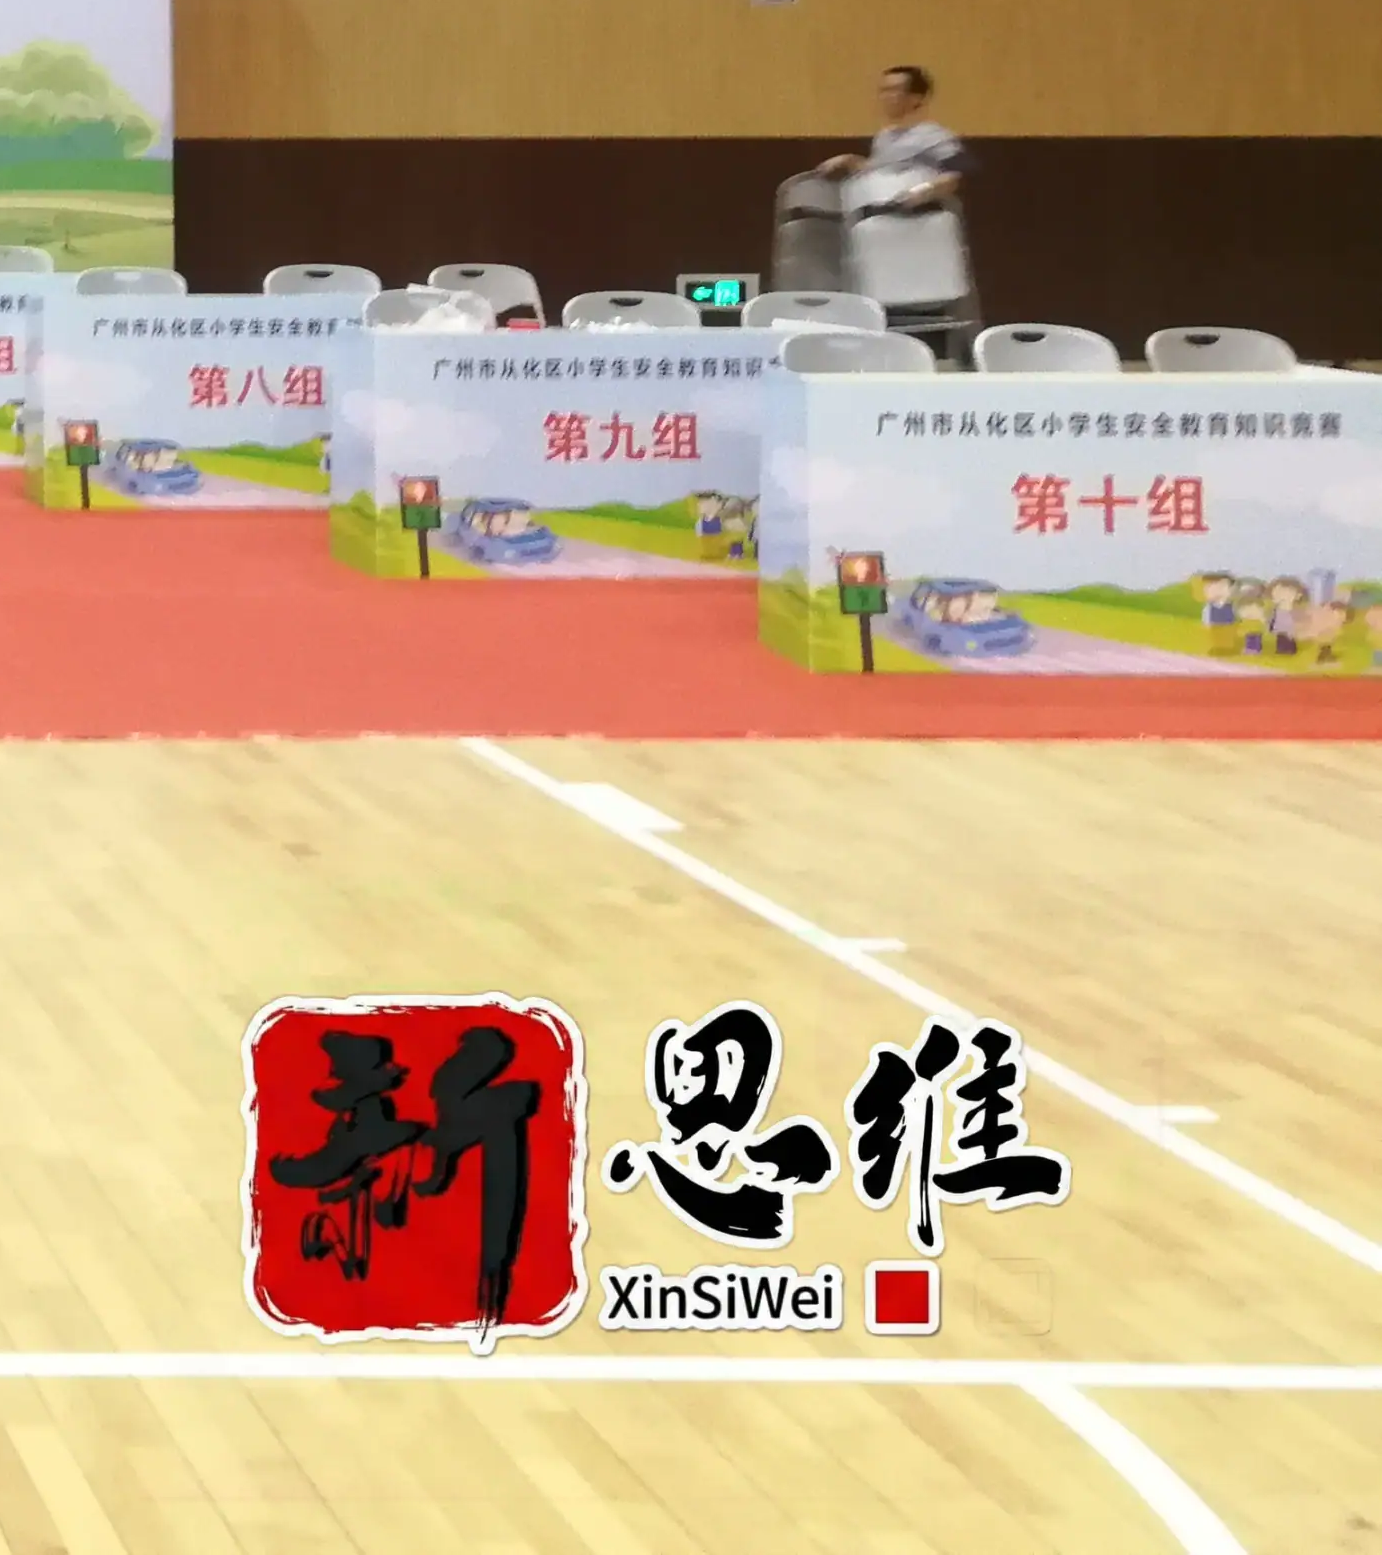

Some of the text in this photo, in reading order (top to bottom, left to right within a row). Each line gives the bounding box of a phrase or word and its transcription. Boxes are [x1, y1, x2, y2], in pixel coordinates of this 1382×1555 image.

[189, 364, 327, 408] 第八组
[544, 410, 702, 462] 第九组
[877, 410, 1343, 438] 广州市从化区小学生安全教育知识竞赛
[1011, 473, 1209, 535] 第十组
